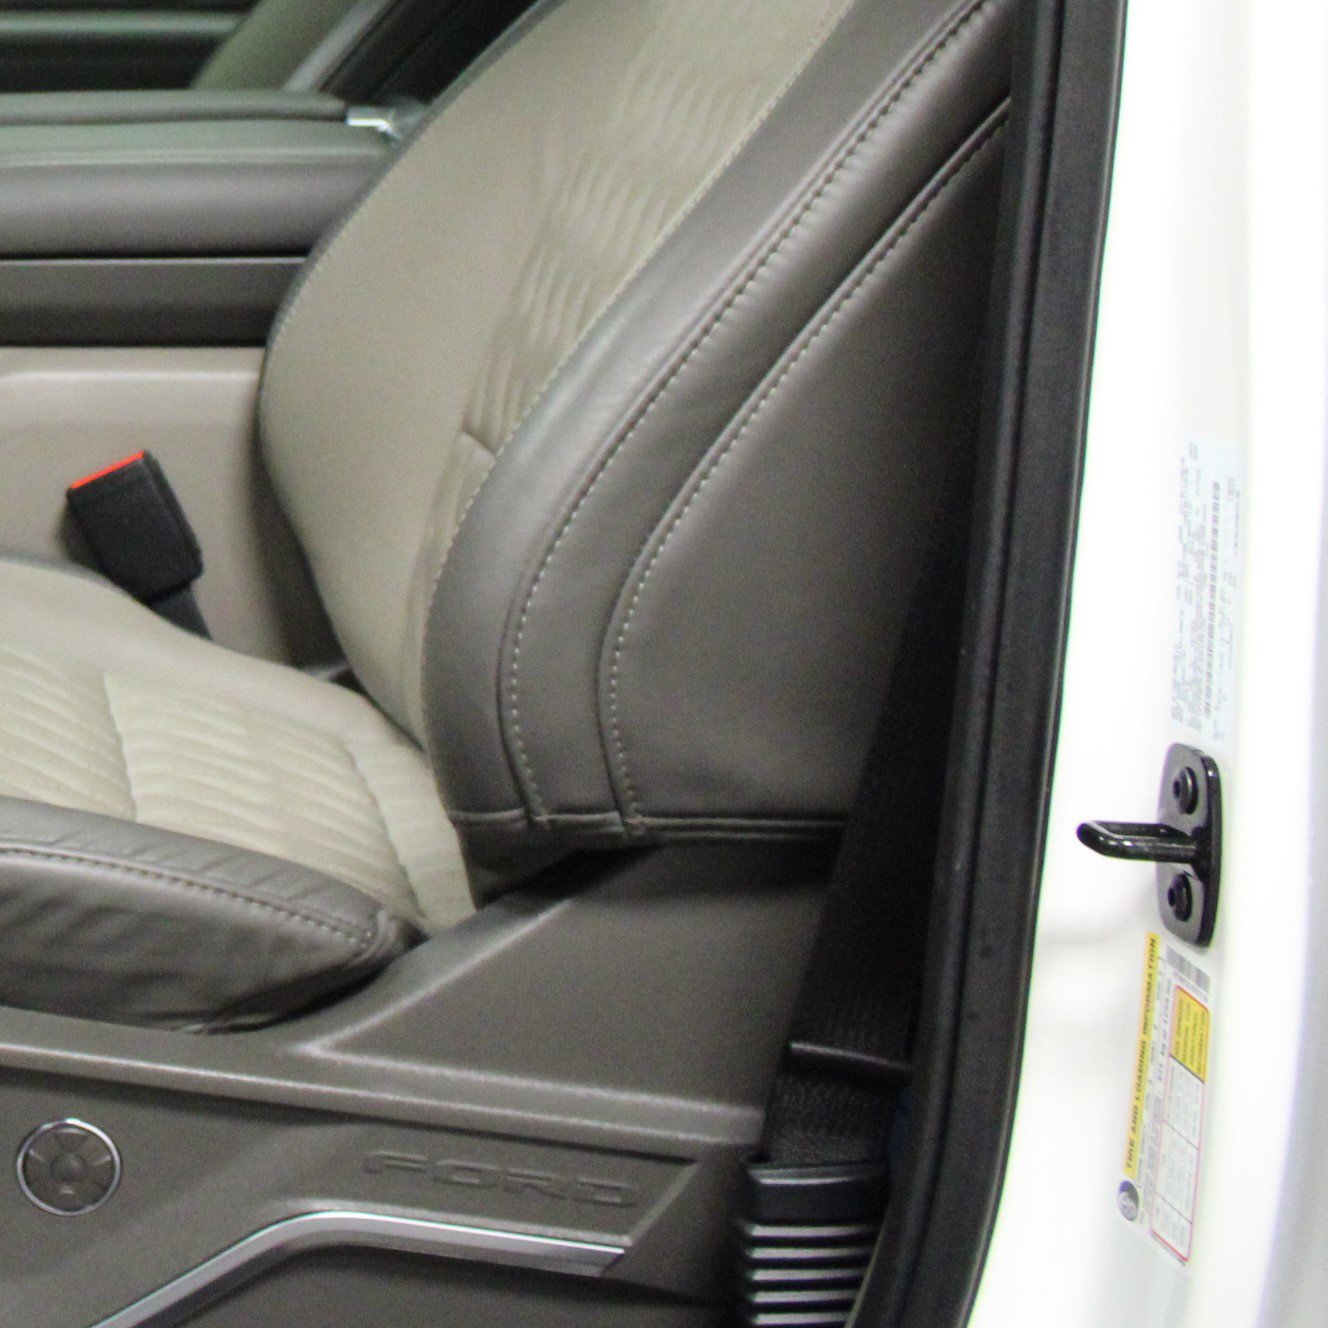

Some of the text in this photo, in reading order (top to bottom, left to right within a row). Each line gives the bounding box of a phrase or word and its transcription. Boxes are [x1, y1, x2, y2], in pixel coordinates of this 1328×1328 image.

[1142, 937, 1157, 1036] INFORMATION
[1134, 1040, 1146, 1102] LOADING
[1131, 1104, 1140, 1135] AND
[363, 1150, 640, 1208] FORD
[1126, 1137, 1136, 1169] TIRE
